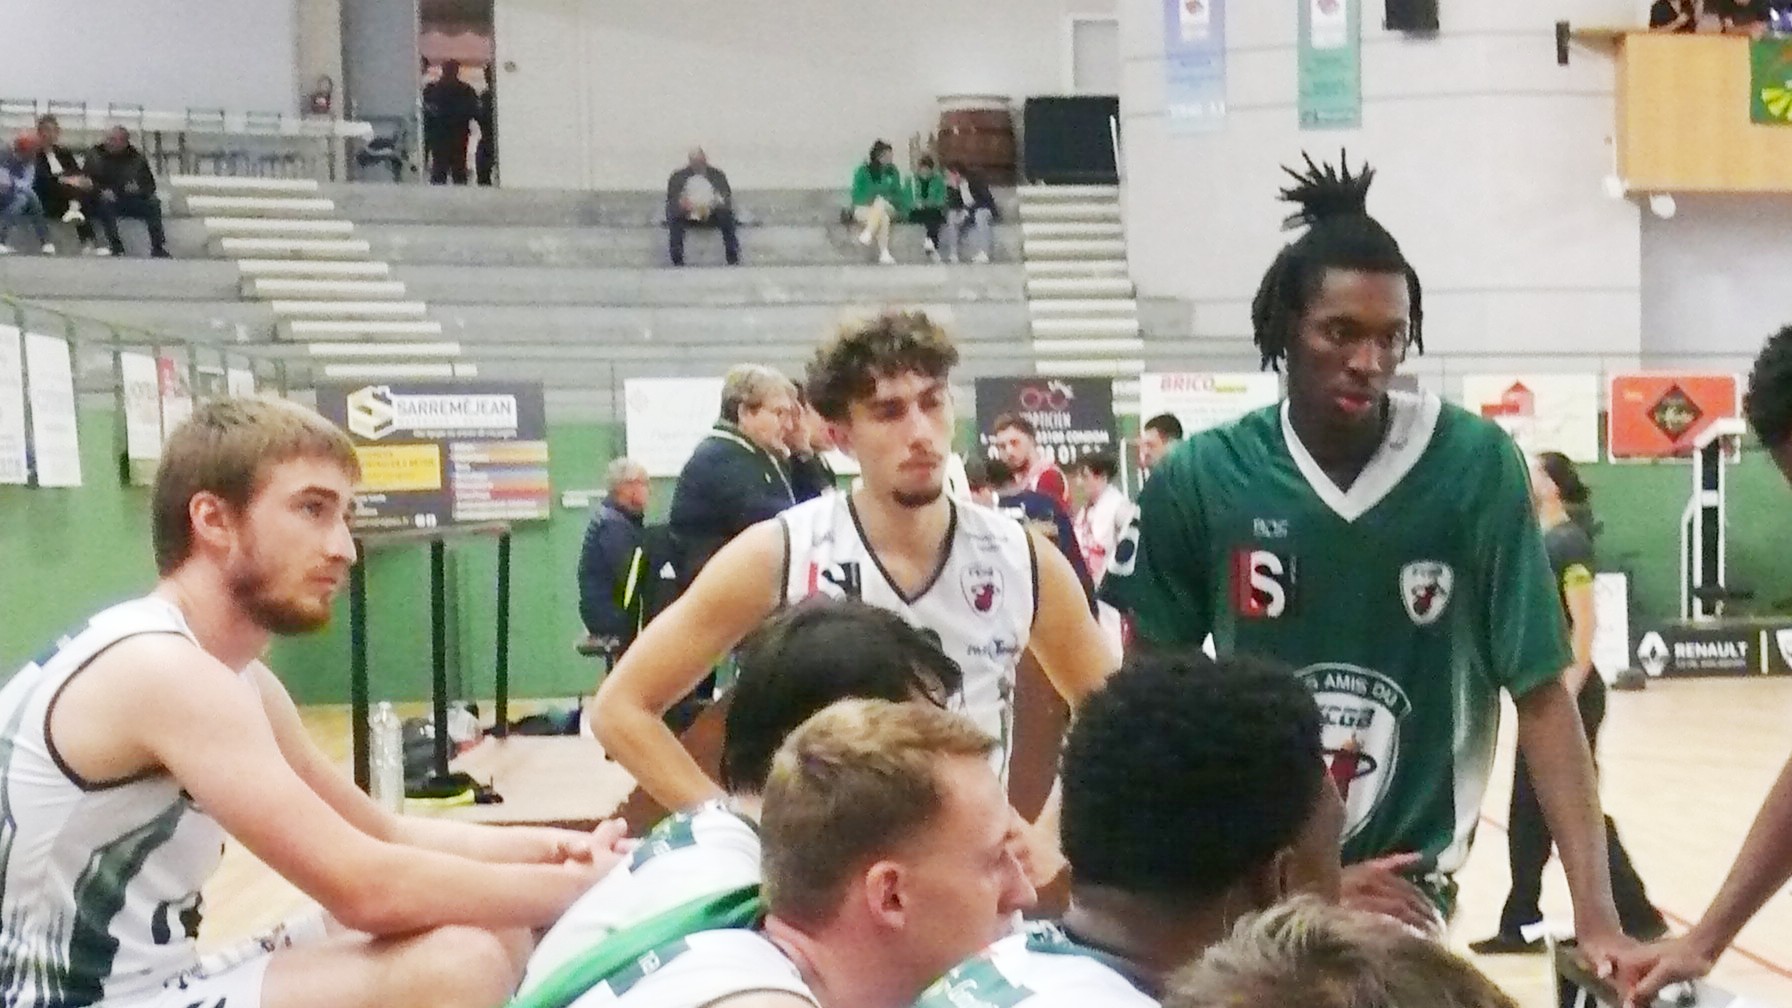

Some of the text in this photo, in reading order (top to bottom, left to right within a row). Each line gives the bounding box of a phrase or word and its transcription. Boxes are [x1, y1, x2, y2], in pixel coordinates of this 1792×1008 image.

[1160, 374, 1215, 392] BRICO
[397, 397, 512, 416] SARREMÉJEAN
[1674, 641, 1748, 659] RENAULT
[1323, 673, 1368, 697] AMIS
